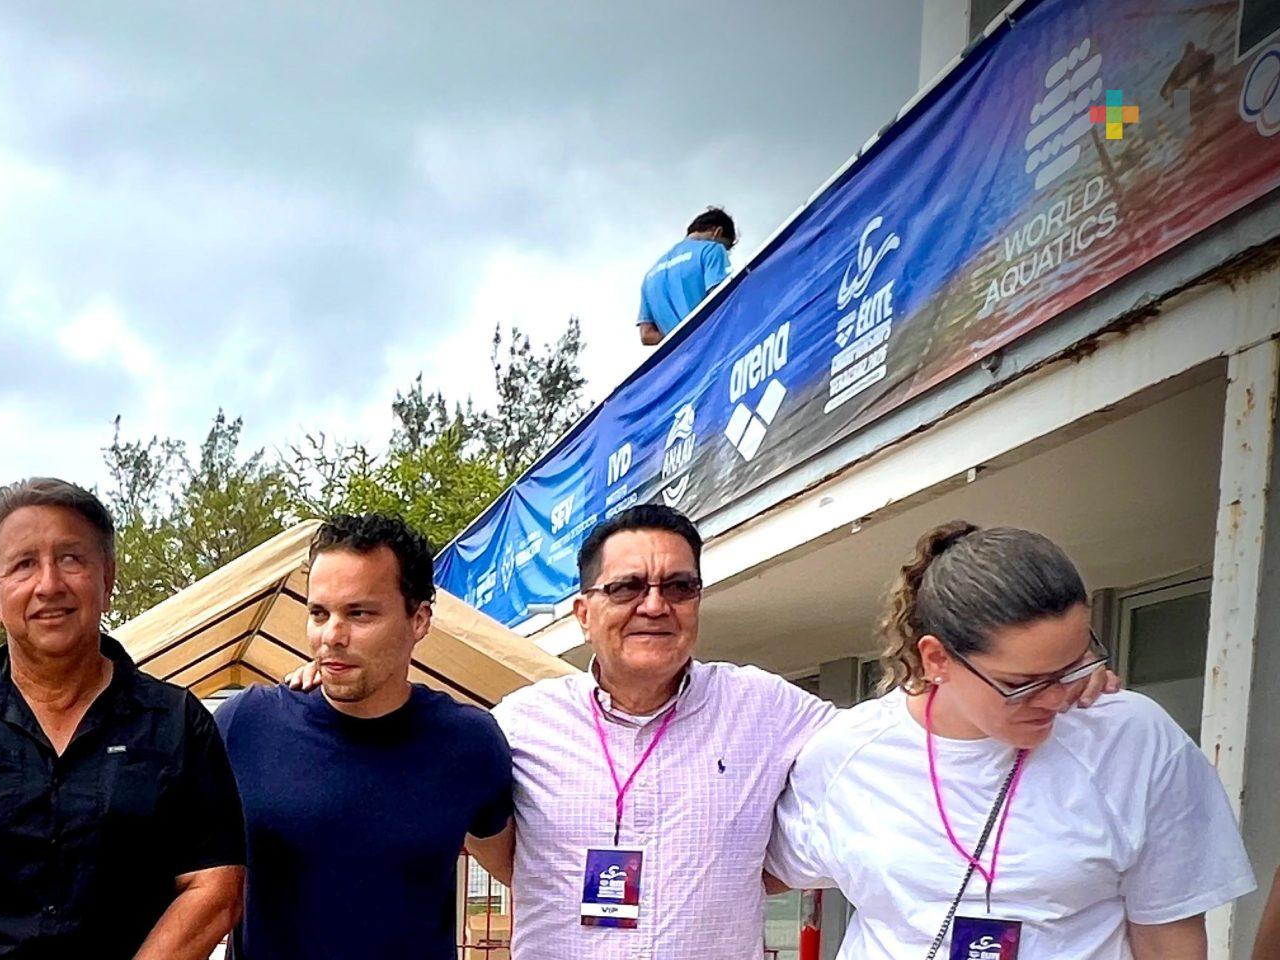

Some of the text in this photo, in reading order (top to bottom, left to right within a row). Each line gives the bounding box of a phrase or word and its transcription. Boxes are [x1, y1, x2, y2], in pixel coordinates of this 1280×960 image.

[984, 201, 1117, 303] AQUATICS
[1005, 175, 1104, 262] WORLD
[730, 321, 791, 404] arena
[607, 442, 632, 487] IVD
